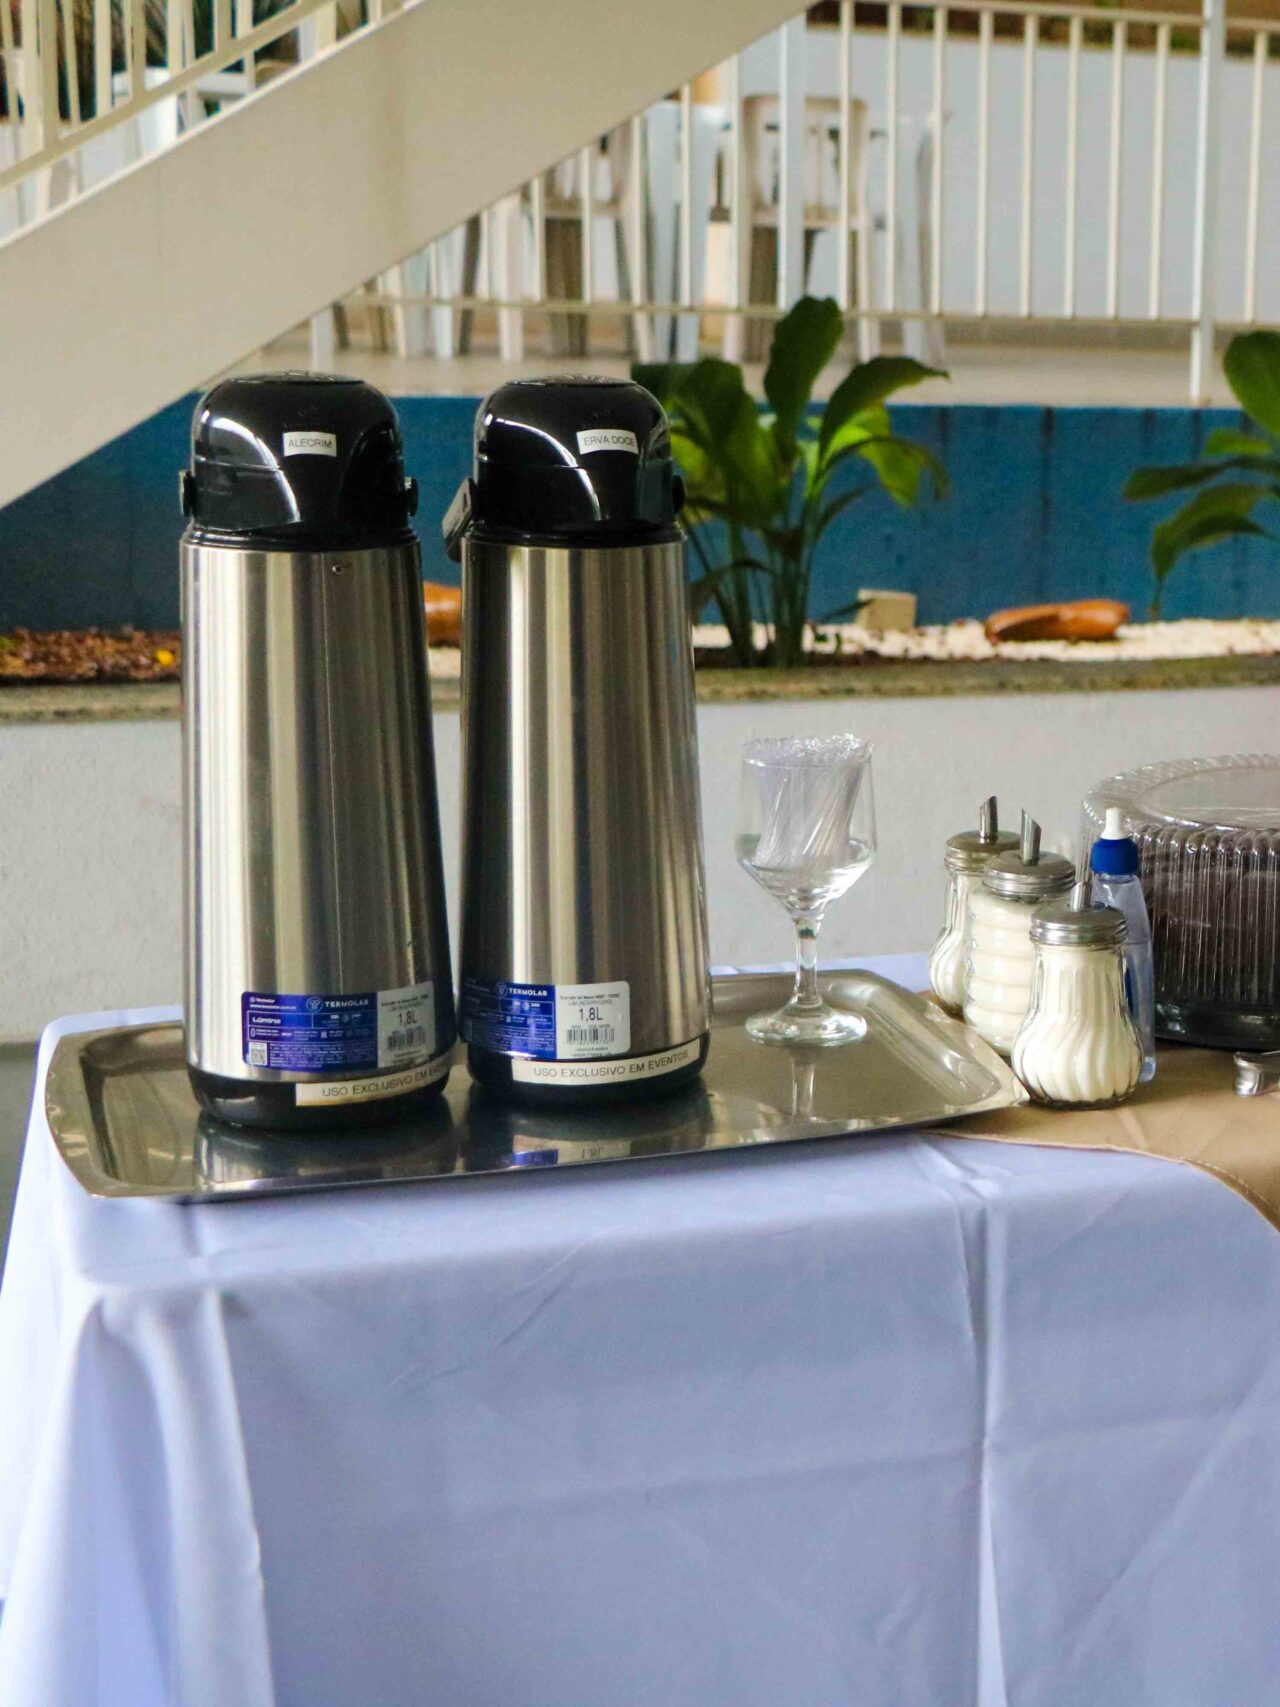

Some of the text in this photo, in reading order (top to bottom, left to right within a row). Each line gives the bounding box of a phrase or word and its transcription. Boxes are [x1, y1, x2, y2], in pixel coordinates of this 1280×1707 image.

[289, 439, 333, 449] ALECRIM
[584, 436, 635, 447] ERVA DOCE
[509, 987, 548, 996] TERMOLAR
[325, 999, 369, 1008] TERMOLAR
[399, 1009, 417, 1027] 1,8L
[579, 1006, 603, 1023] 1,8L
[534, 1050, 689, 1078] USO EXCLUSIVO EM EVENTOS
[322, 1086, 348, 1097] USO
[352, 1074, 412, 1095] EXCLUSIVO
[414, 1068, 428, 1082] EM
